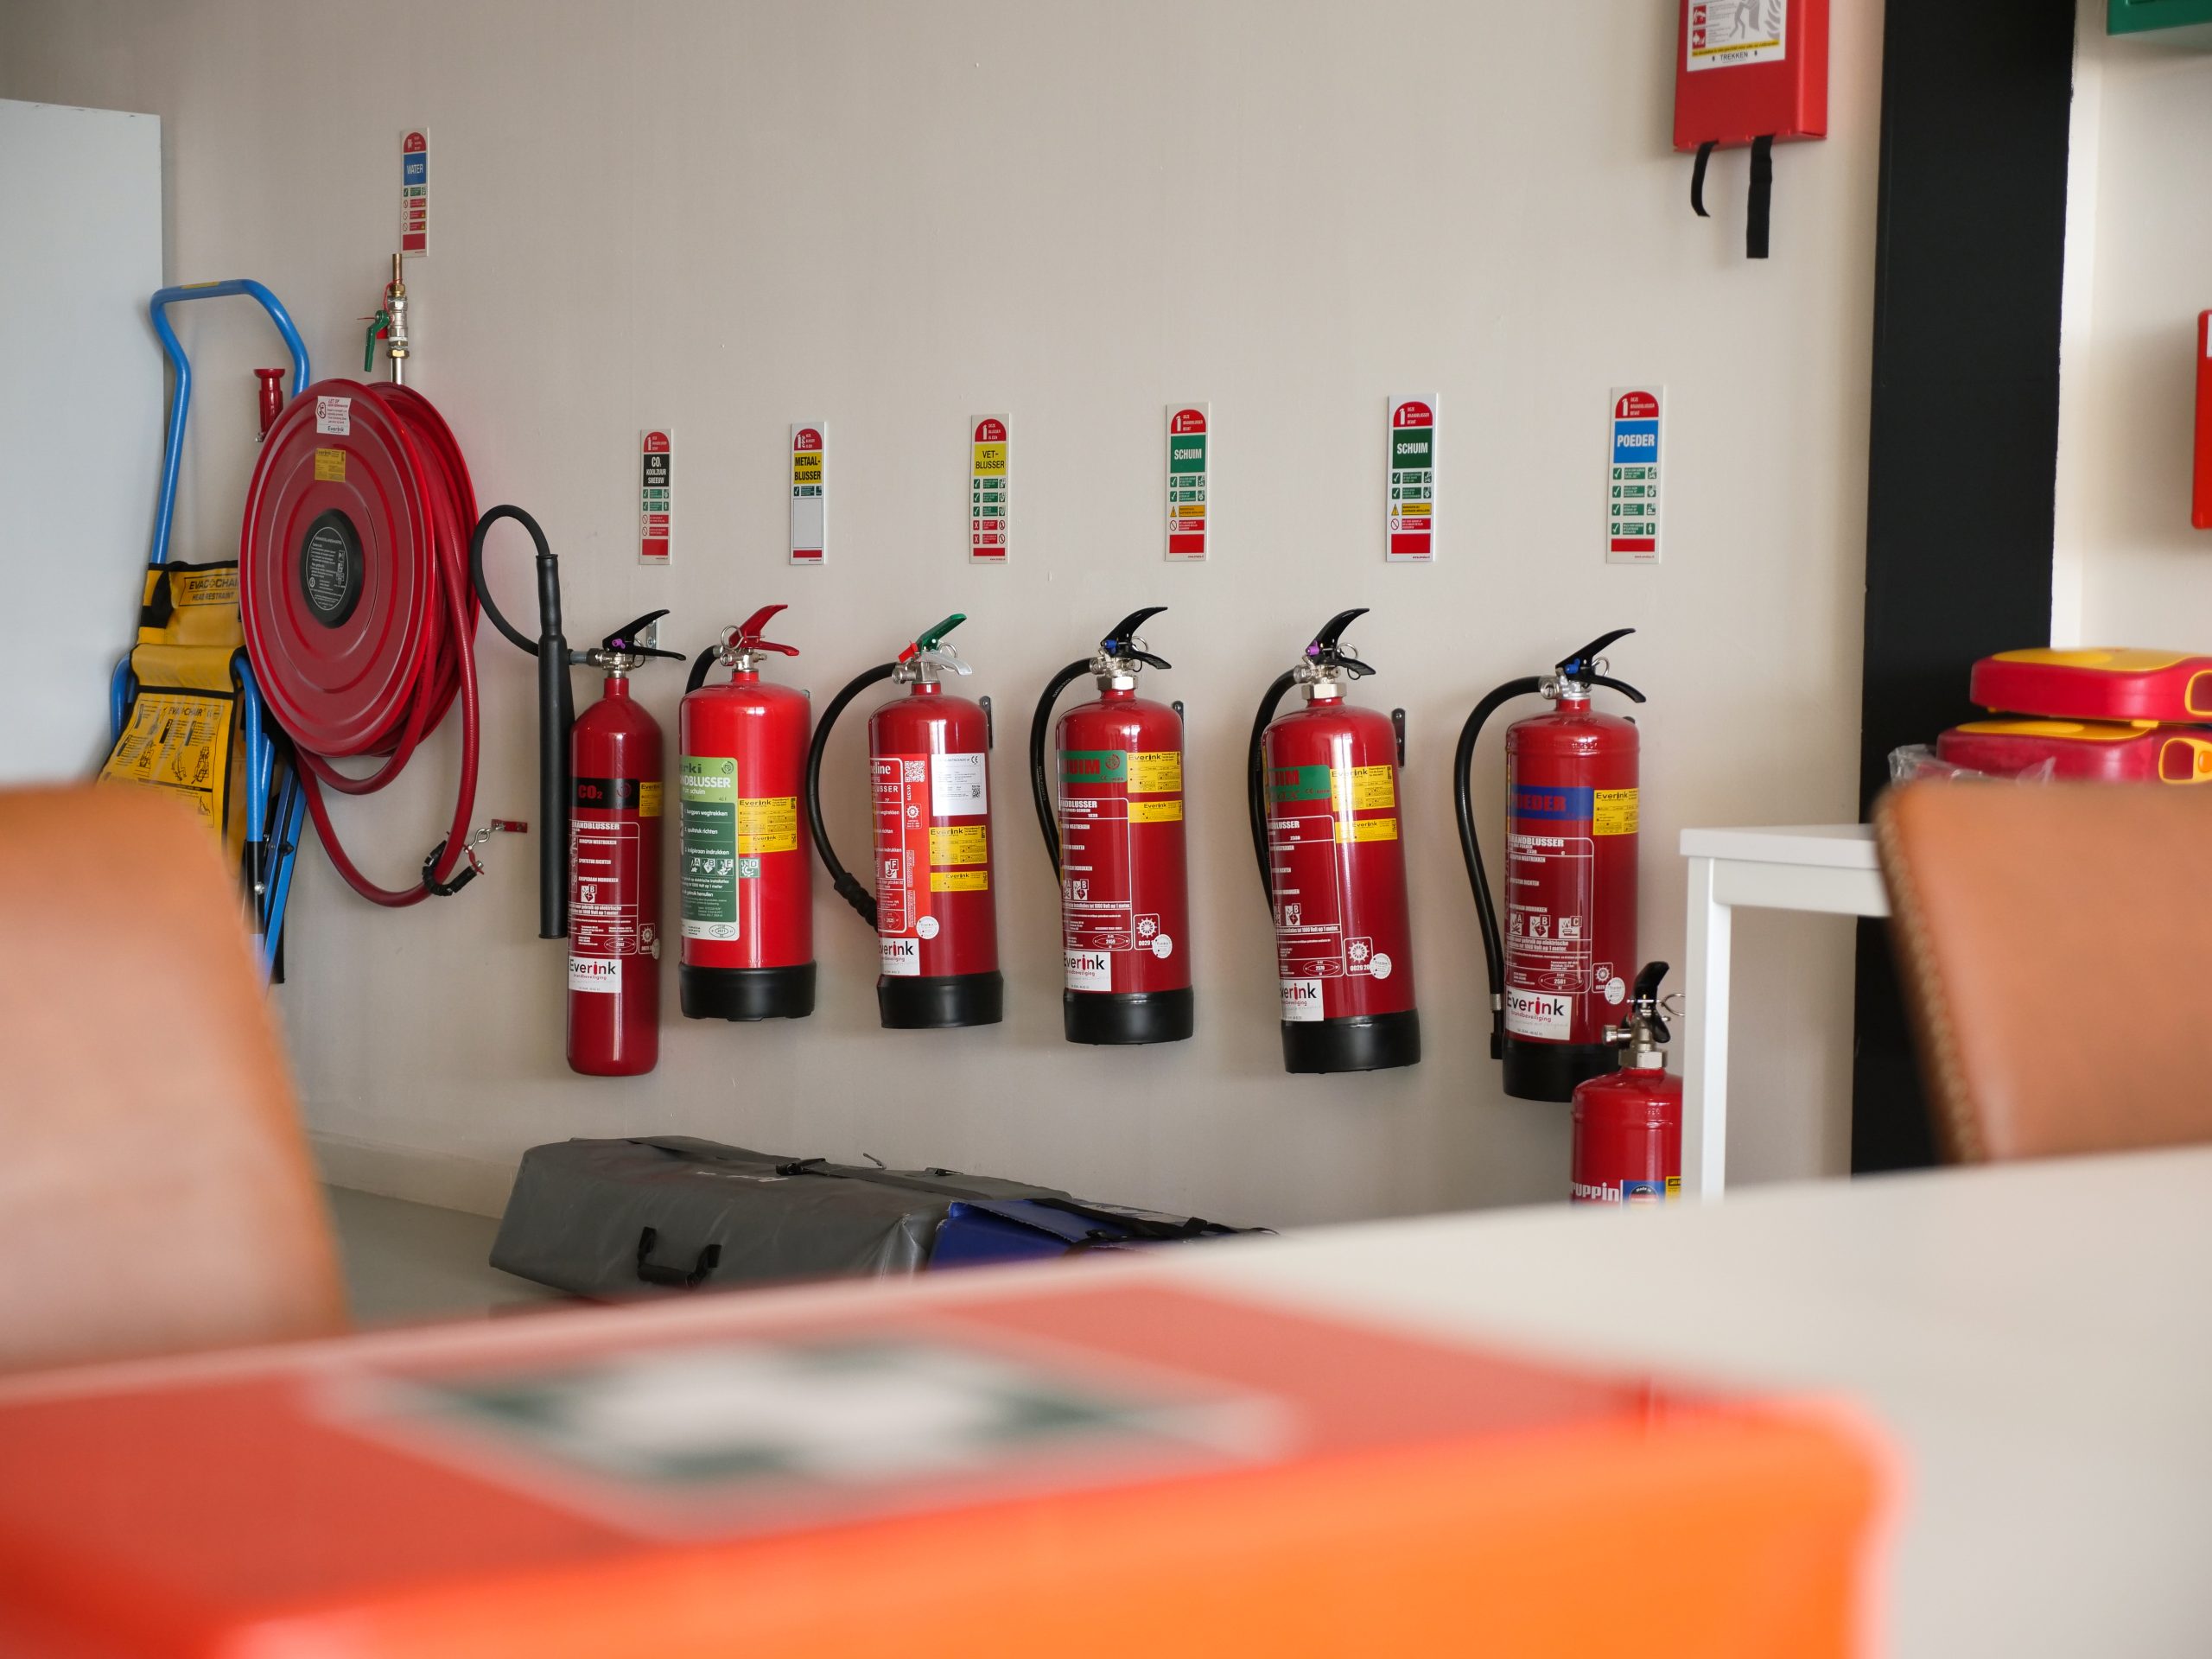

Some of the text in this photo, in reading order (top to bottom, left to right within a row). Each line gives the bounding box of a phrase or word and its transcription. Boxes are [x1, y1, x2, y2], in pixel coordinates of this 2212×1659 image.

[1720, 52, 1748, 61] TREKKEN
[407, 163, 423, 175] WATER
[1618, 434, 1655, 448] POEDER
[1397, 442, 1428, 454] SCHUIM
[982, 450, 999, 459] VET-
[1174, 448, 1202, 460] SCHUIM
[795, 456, 821, 467] METAAL-
[976, 461, 1005, 469] BLUSSER
[794, 470, 821, 481] BLUSSER
[215, 577, 238, 588] CHAI
[1128, 753, 1161, 762] Everink
[1596, 791, 1628, 801] Everink
[892, 859, 897, 868] F
[1541, 916, 1548, 925] B
[1573, 917, 1579, 925] C
[880, 940, 914, 957] verink
[570, 959, 616, 975] Everink
[1281, 982, 1317, 1001] verink
[1507, 990, 1564, 1016] Everink
